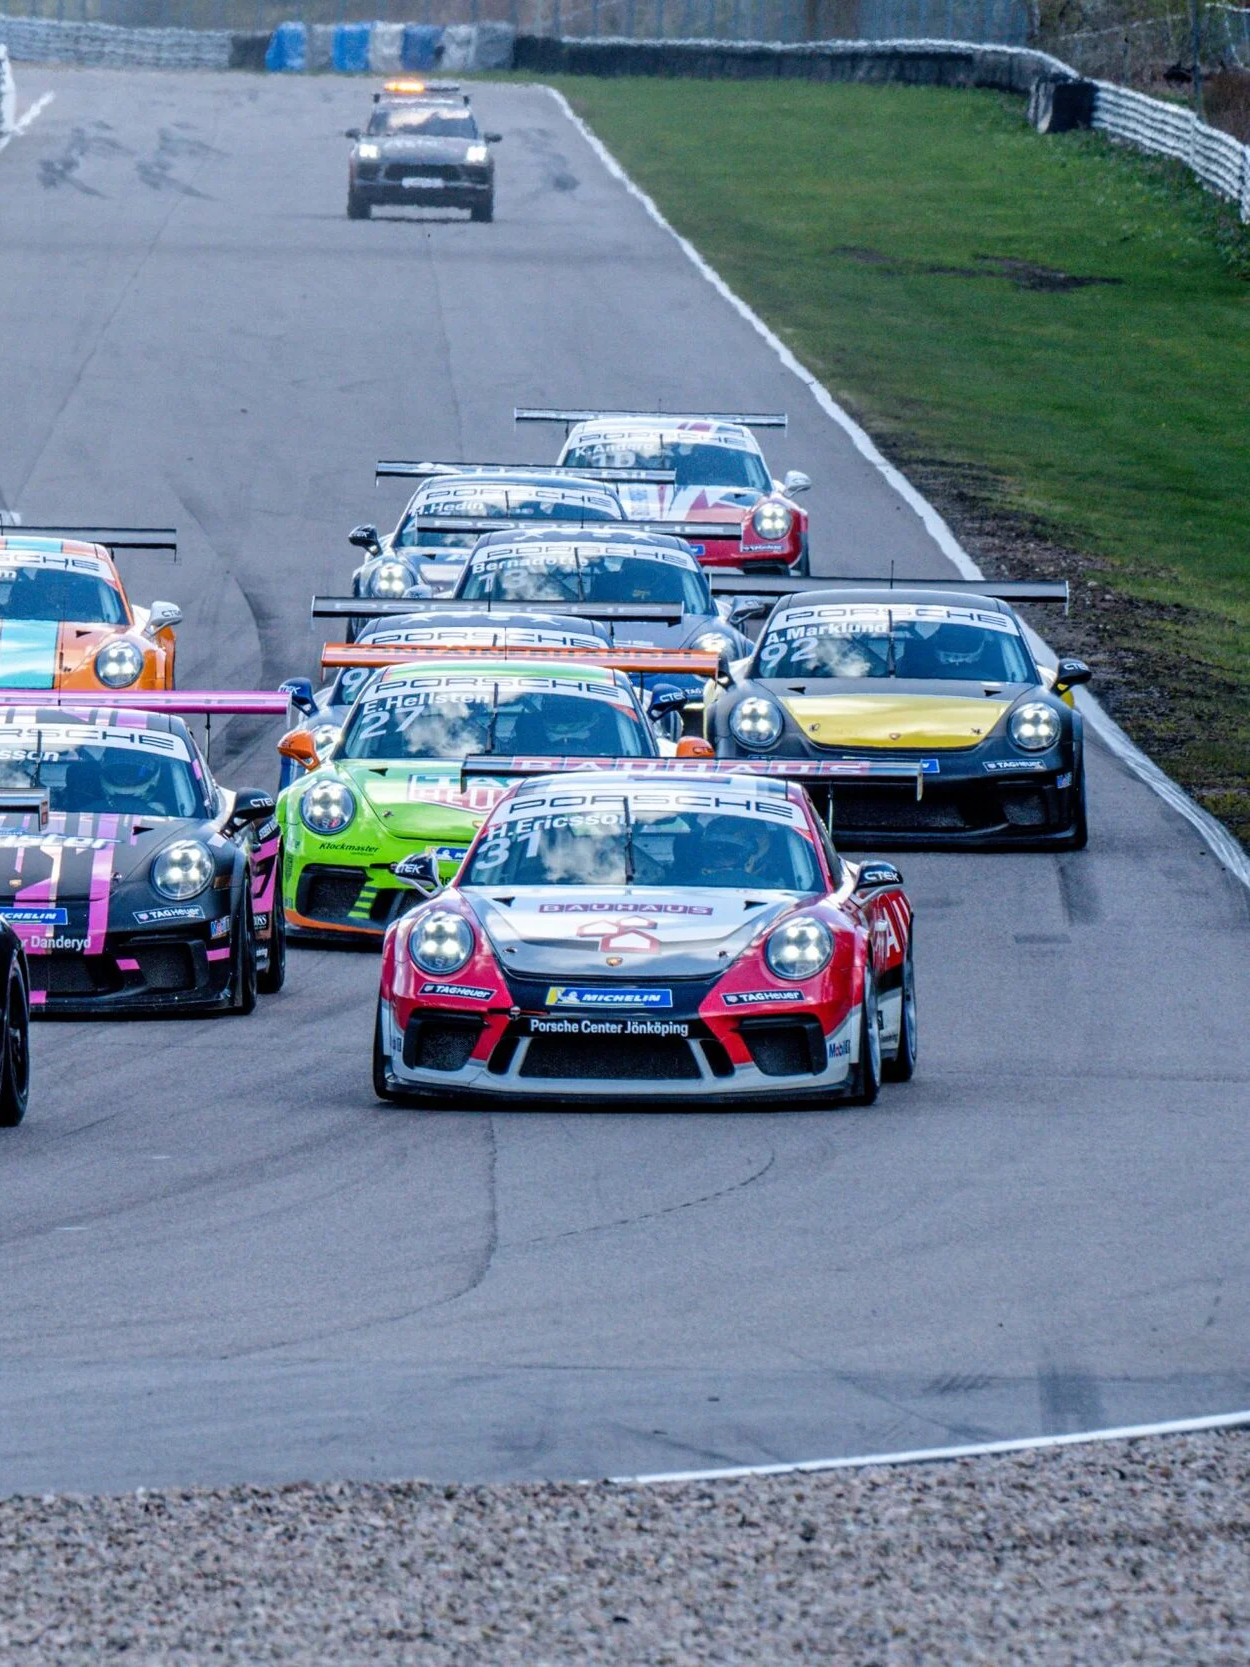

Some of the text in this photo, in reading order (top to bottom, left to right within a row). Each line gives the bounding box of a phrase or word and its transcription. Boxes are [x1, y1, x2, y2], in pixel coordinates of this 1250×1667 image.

[579, 432, 749, 448] PORSCHE
[427, 489, 612, 508] PORSCHE
[487, 546, 688, 568] PORSCHE
[335, 602, 662, 615] PORSCHE
[786, 608, 1007, 628] PORSCHE
[372, 632, 601, 649] PORSCHE
[767, 622, 889, 644] A.Marklund
[760, 637, 819, 668] 92
[375, 677, 619, 698] PORSCHE
[363, 691, 491, 716] E.Hellsten
[359, 705, 425, 740] 27
[520, 761, 867, 775] BAUHAUS
[414, 790, 496, 810] HEU
[509, 796, 794, 819] PORSCHE
[487, 812, 638, 843] H.Ericsson
[319, 842, 380, 853] Klockmaster
[476, 829, 541, 870] 31
[864, 870, 899, 882] CTEK
[0, 912, 58, 920] ICHELIN
[150, 908, 200, 919] TAGHeuer
[543, 903, 710, 915] BAUHAUS
[31, 935, 92, 950] Danderyd
[435, 985, 491, 998] TAGHeuer
[582, 994, 661, 1002] MICHELIN
[740, 991, 800, 1001] TAGHeuer
[530, 1019, 689, 1038] Porsche Center Jönköping
